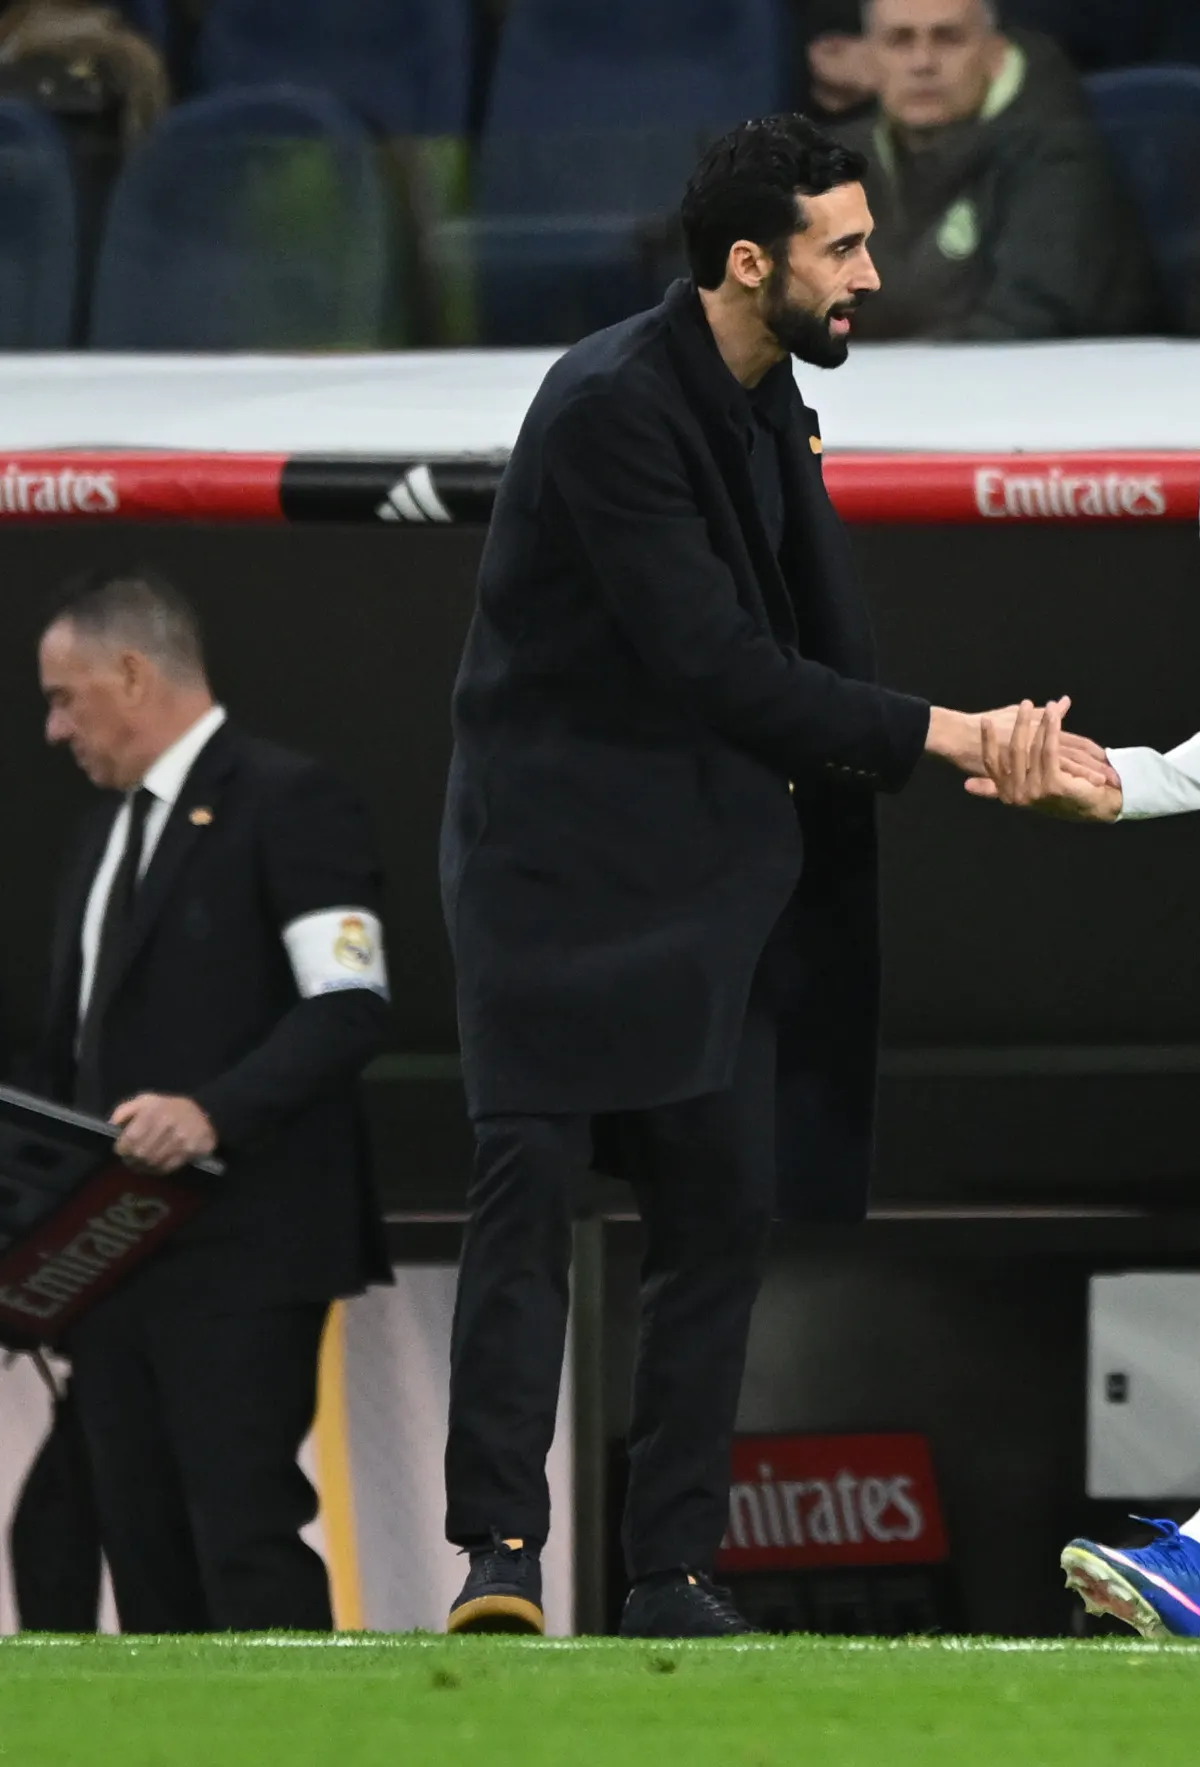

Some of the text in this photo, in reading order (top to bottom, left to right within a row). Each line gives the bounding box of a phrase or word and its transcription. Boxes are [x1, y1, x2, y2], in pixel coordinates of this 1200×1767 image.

[0, 463, 118, 512] irates
[975, 467, 1166, 517] Emirates
[0, 1192, 170, 1318] Emirates
